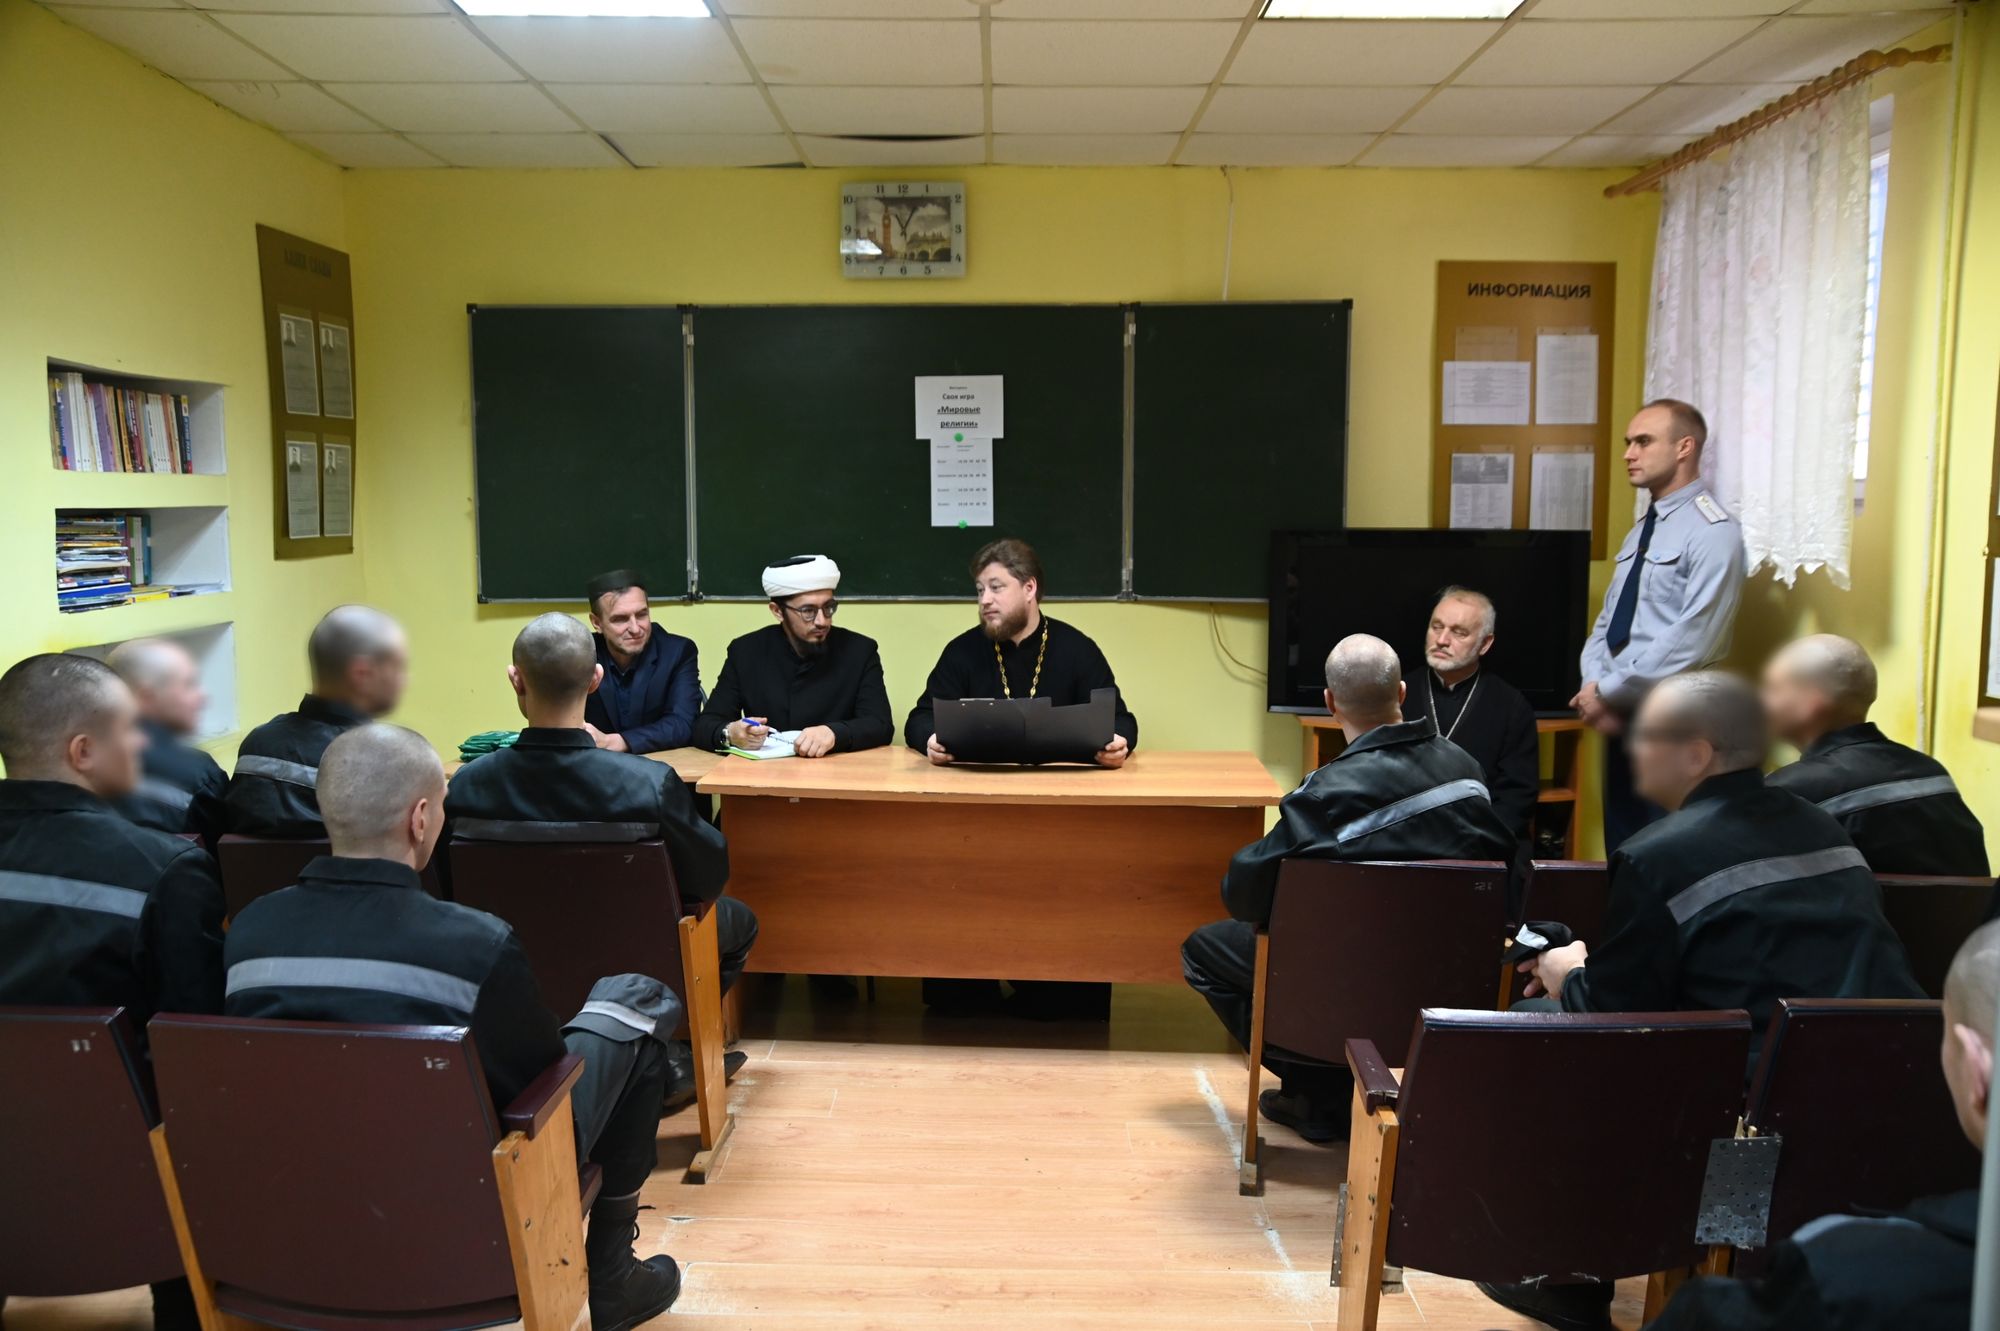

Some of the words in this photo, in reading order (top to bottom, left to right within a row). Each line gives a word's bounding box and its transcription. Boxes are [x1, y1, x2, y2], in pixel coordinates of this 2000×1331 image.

[875, 184, 885, 194] 11
[897, 184, 909, 194] 12
[843, 195, 853, 205] 10
[954, 194, 962, 203] 2
[844, 225, 852, 235] 9
[954, 224, 962, 233] 3
[845, 254, 853, 265] 8
[955, 253, 961, 262] 4
[878, 266, 884, 275] 7
[900, 266, 907, 275] 6
[924, 266, 932, 275] 5
[1467, 282, 1592, 300] ИНФОРМАЦИЯ
[959, 393, 975, 401] игра
[937, 405, 981, 415] «Мировые
[940, 420, 978, 429] религии»
[623, 854, 635, 864] 7
